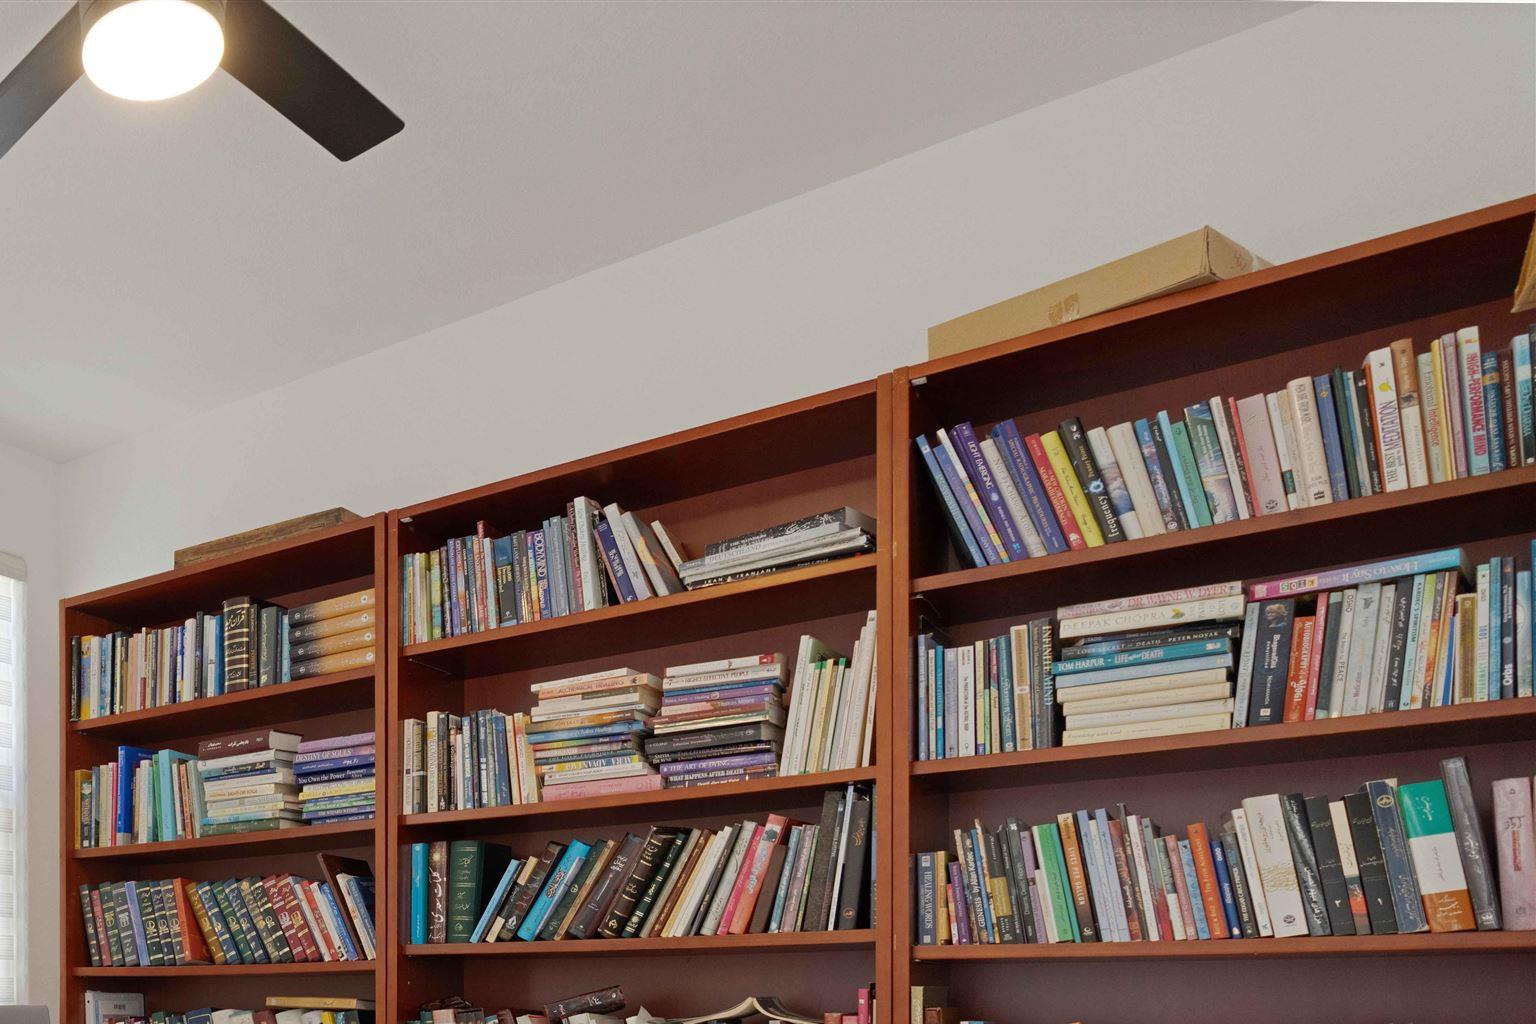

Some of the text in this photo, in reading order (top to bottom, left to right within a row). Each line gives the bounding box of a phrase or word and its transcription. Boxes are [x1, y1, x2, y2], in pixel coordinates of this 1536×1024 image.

[1424, 370, 1441, 447] Emotional Intelligence
[1378, 400, 1401, 450] MEDITATION
[1473, 434, 1487, 457] MIND
[1094, 492, 1121, 541] frequency
[1147, 590, 1182, 604] WAYNE
[1198, 584, 1228, 597] DYER
[1344, 593, 1354, 614] OSHO
[1063, 610, 1167, 632] DEEPAK CHOPRA
[1192, 631, 1219, 641] NOVAK
[1299, 621, 1313, 670] AUTOBIOGRAPHY
[1042, 624, 1053, 706] INFINITE MIND
[1058, 660, 1074, 671] TOM
[1073, 657, 1105, 670] HARPUR
[1114, 653, 1128, 664] LIFE
[1141, 649, 1164, 661] DEATH
[1502, 664, 1513, 686] Orbs
[1067, 846, 1078, 865] LIVES
[922, 870, 935, 930] HEALING WORDS
[974, 896, 986, 928] GENESIS
